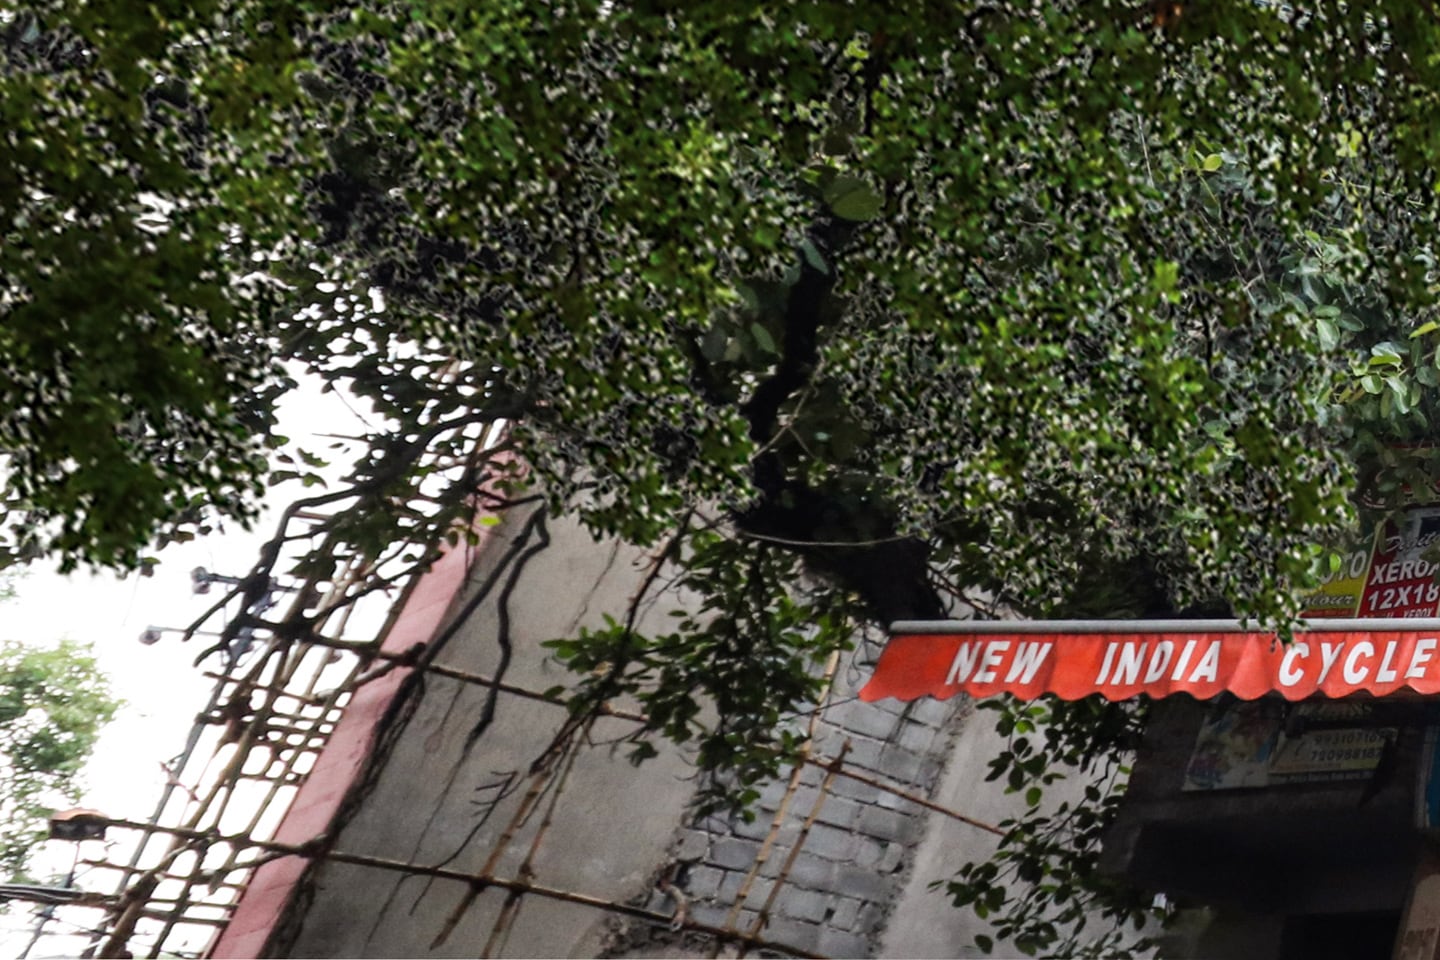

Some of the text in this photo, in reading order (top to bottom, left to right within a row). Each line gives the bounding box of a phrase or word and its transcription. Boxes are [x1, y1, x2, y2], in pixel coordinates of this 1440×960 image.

[1368, 582, 1440, 612] 12X18
[945, 640, 1052, 685] NEW
[1095, 640, 1221, 685] INDIA
[1279, 638, 1437, 686] CYCLE
